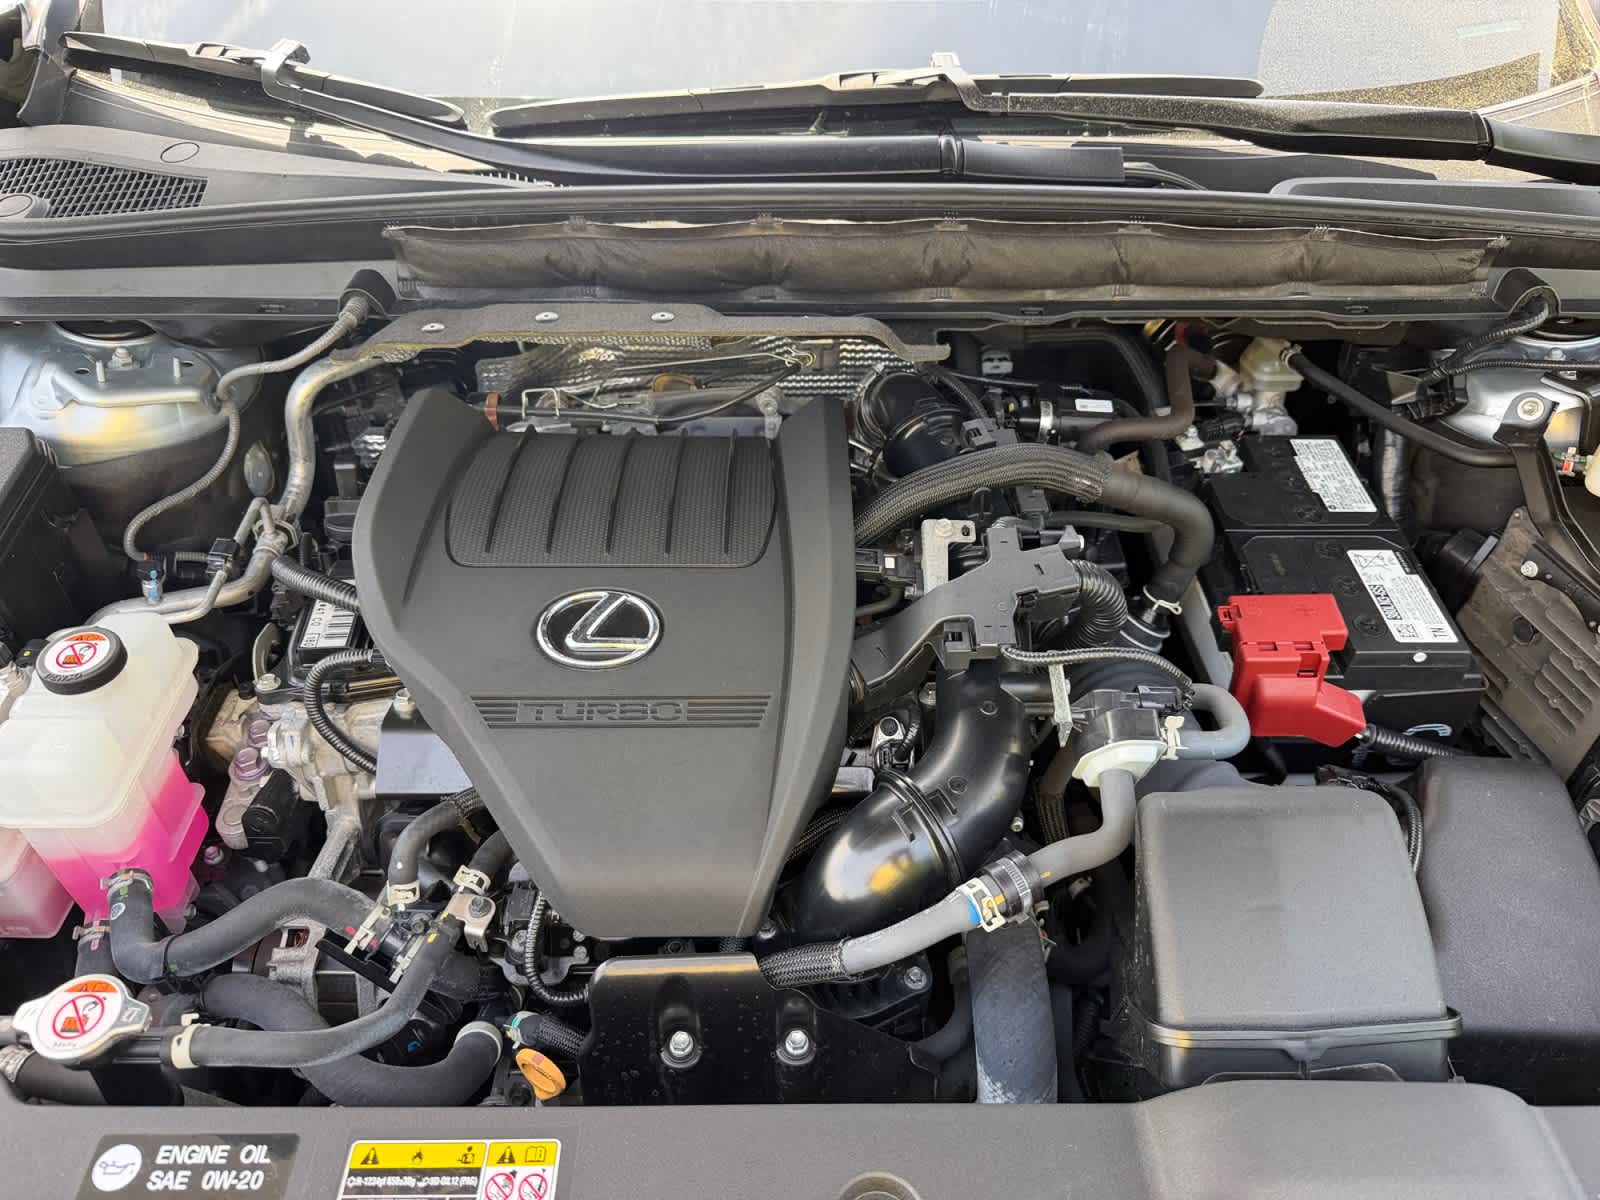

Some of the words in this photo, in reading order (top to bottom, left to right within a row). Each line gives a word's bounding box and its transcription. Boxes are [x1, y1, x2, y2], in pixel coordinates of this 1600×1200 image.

[516, 701, 686, 722] TURBO
[155, 1144, 231, 1165] ENGINE
[239, 1144, 272, 1165] OIL
[146, 1170, 192, 1191] SAE
[201, 1170, 265, 1191] 0W-20
